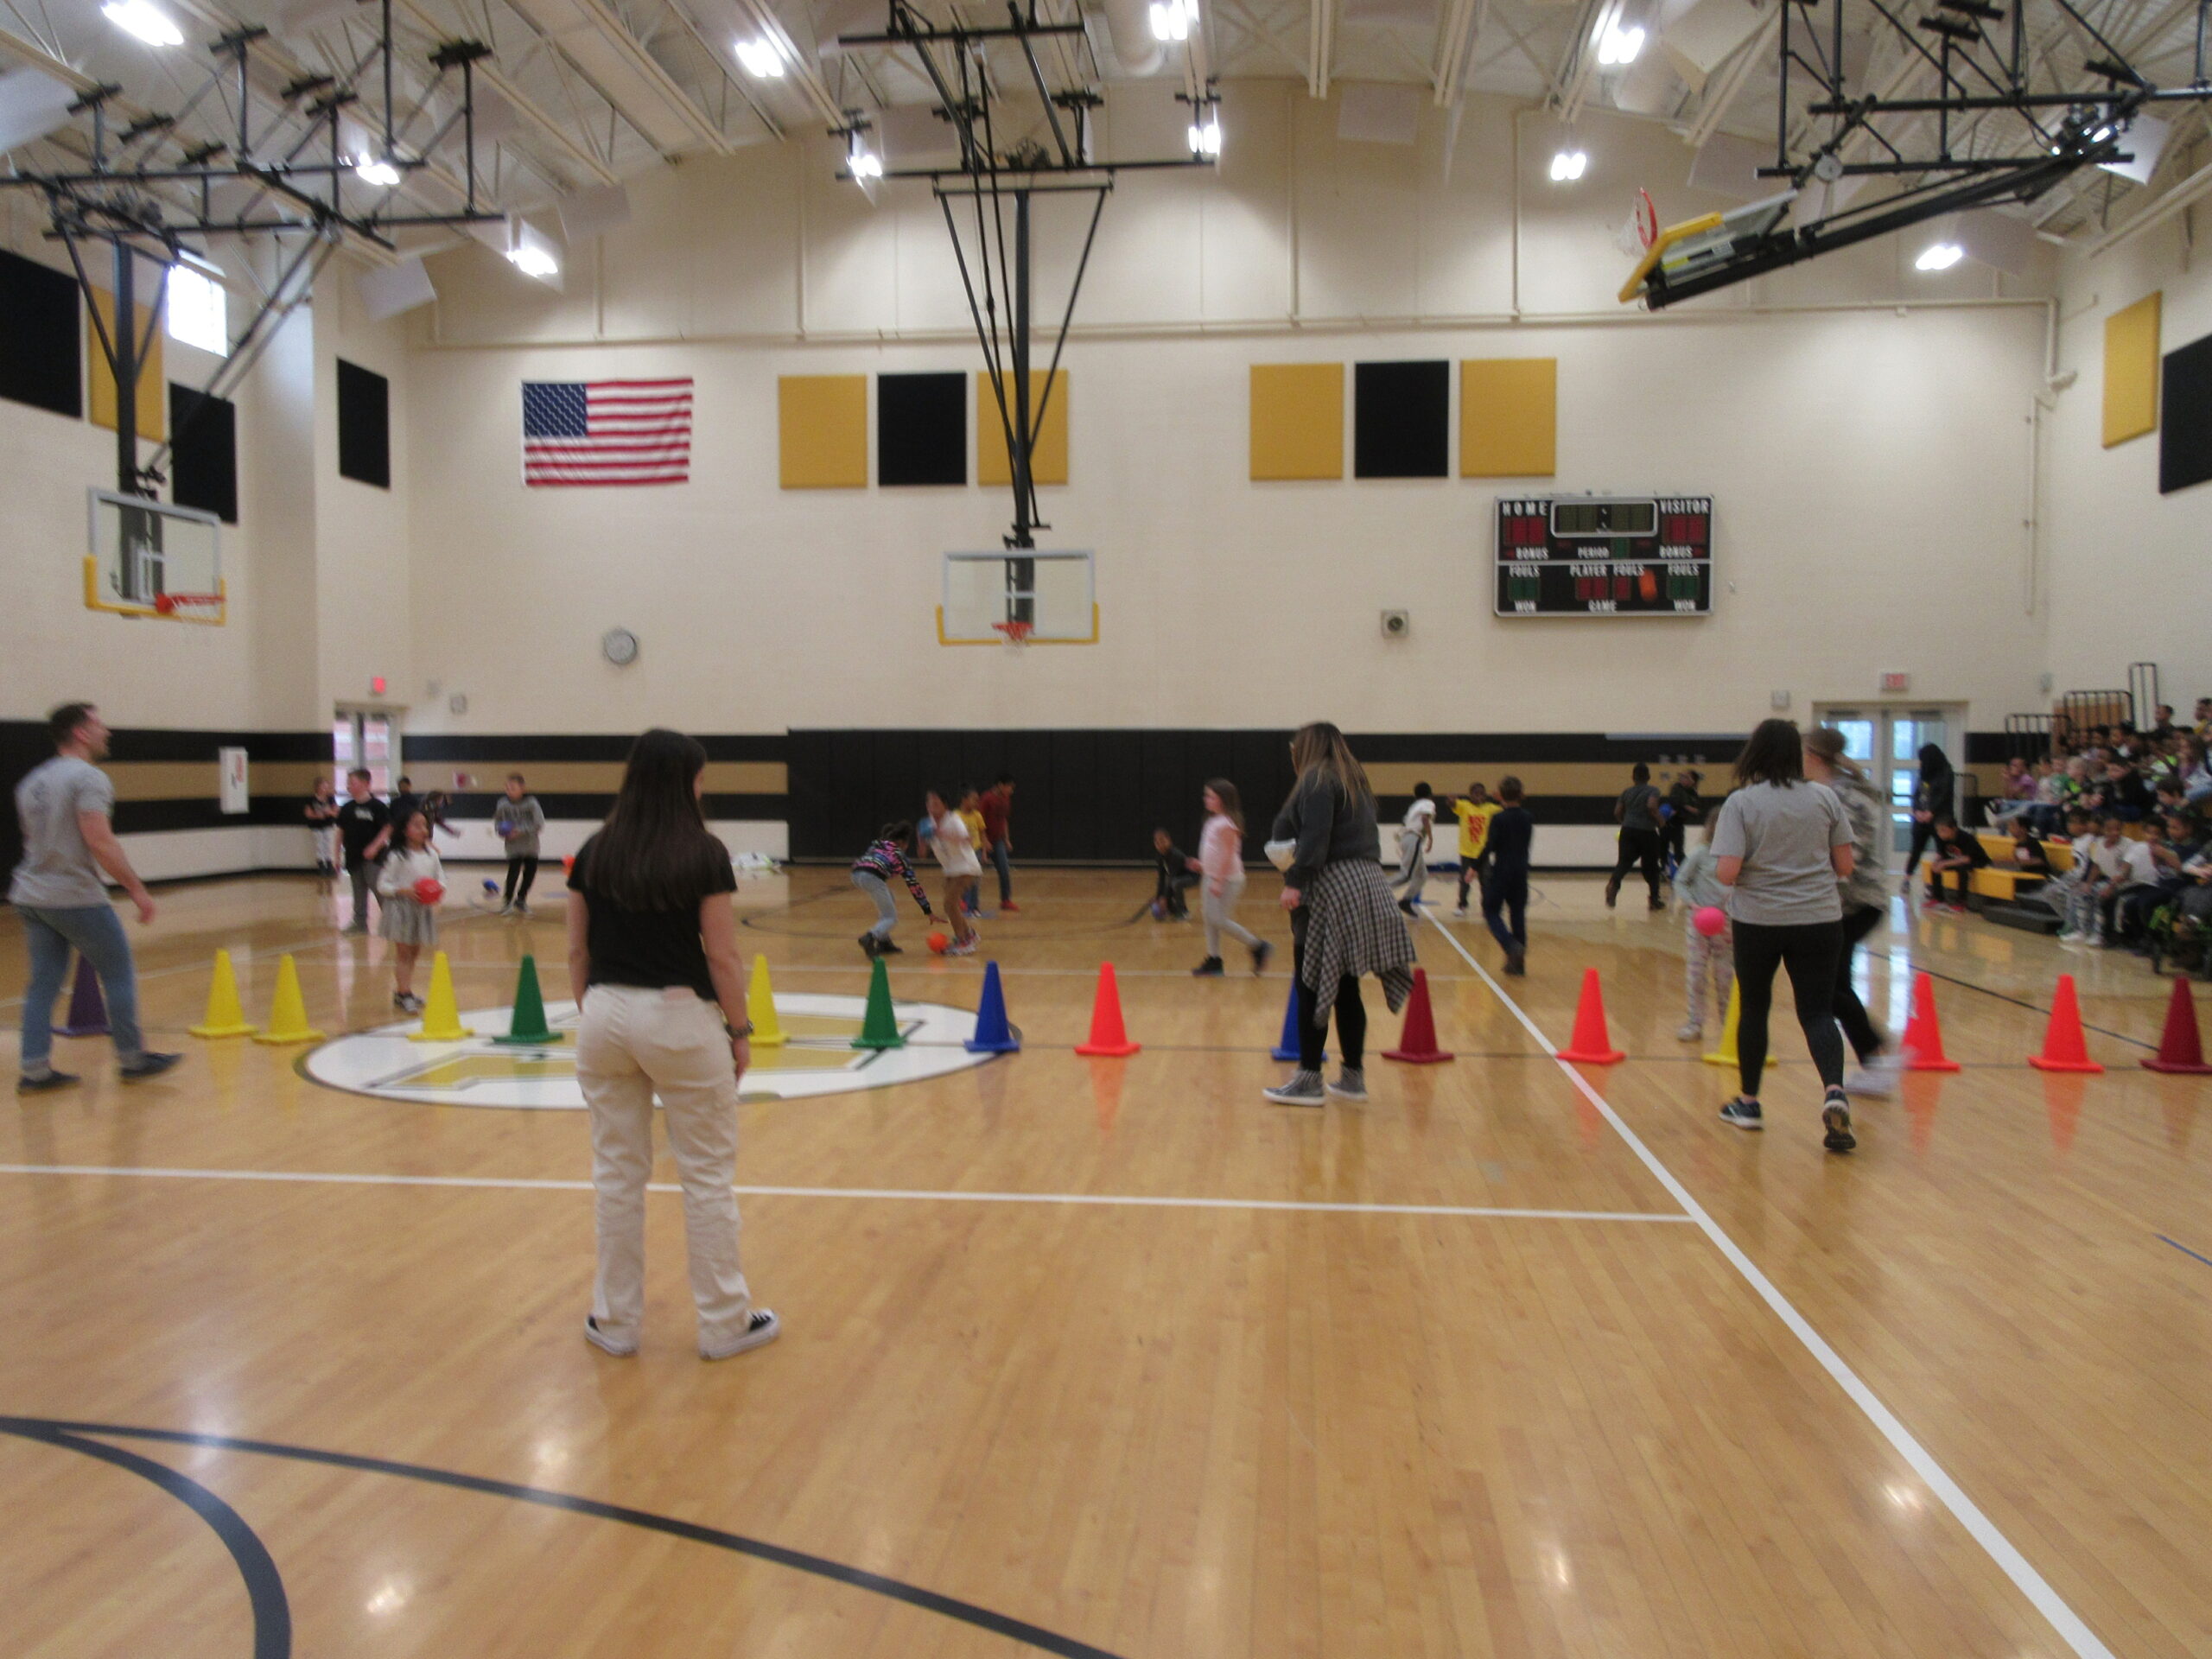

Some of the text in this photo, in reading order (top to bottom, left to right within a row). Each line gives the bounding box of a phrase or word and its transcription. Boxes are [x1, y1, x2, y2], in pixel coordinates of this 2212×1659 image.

[1660, 499, 1709, 514] VISITOR
[1516, 546, 1549, 559] BONUS
[1577, 546, 1610, 559] PERIOD
[1659, 545, 1693, 558] BONUS
[1510, 565, 1540, 577] FOULS
[1569, 563, 1644, 577] PLAYER FOULS
[1668, 563, 1700, 576] FOULS
[1588, 600, 1617, 613] GAME
